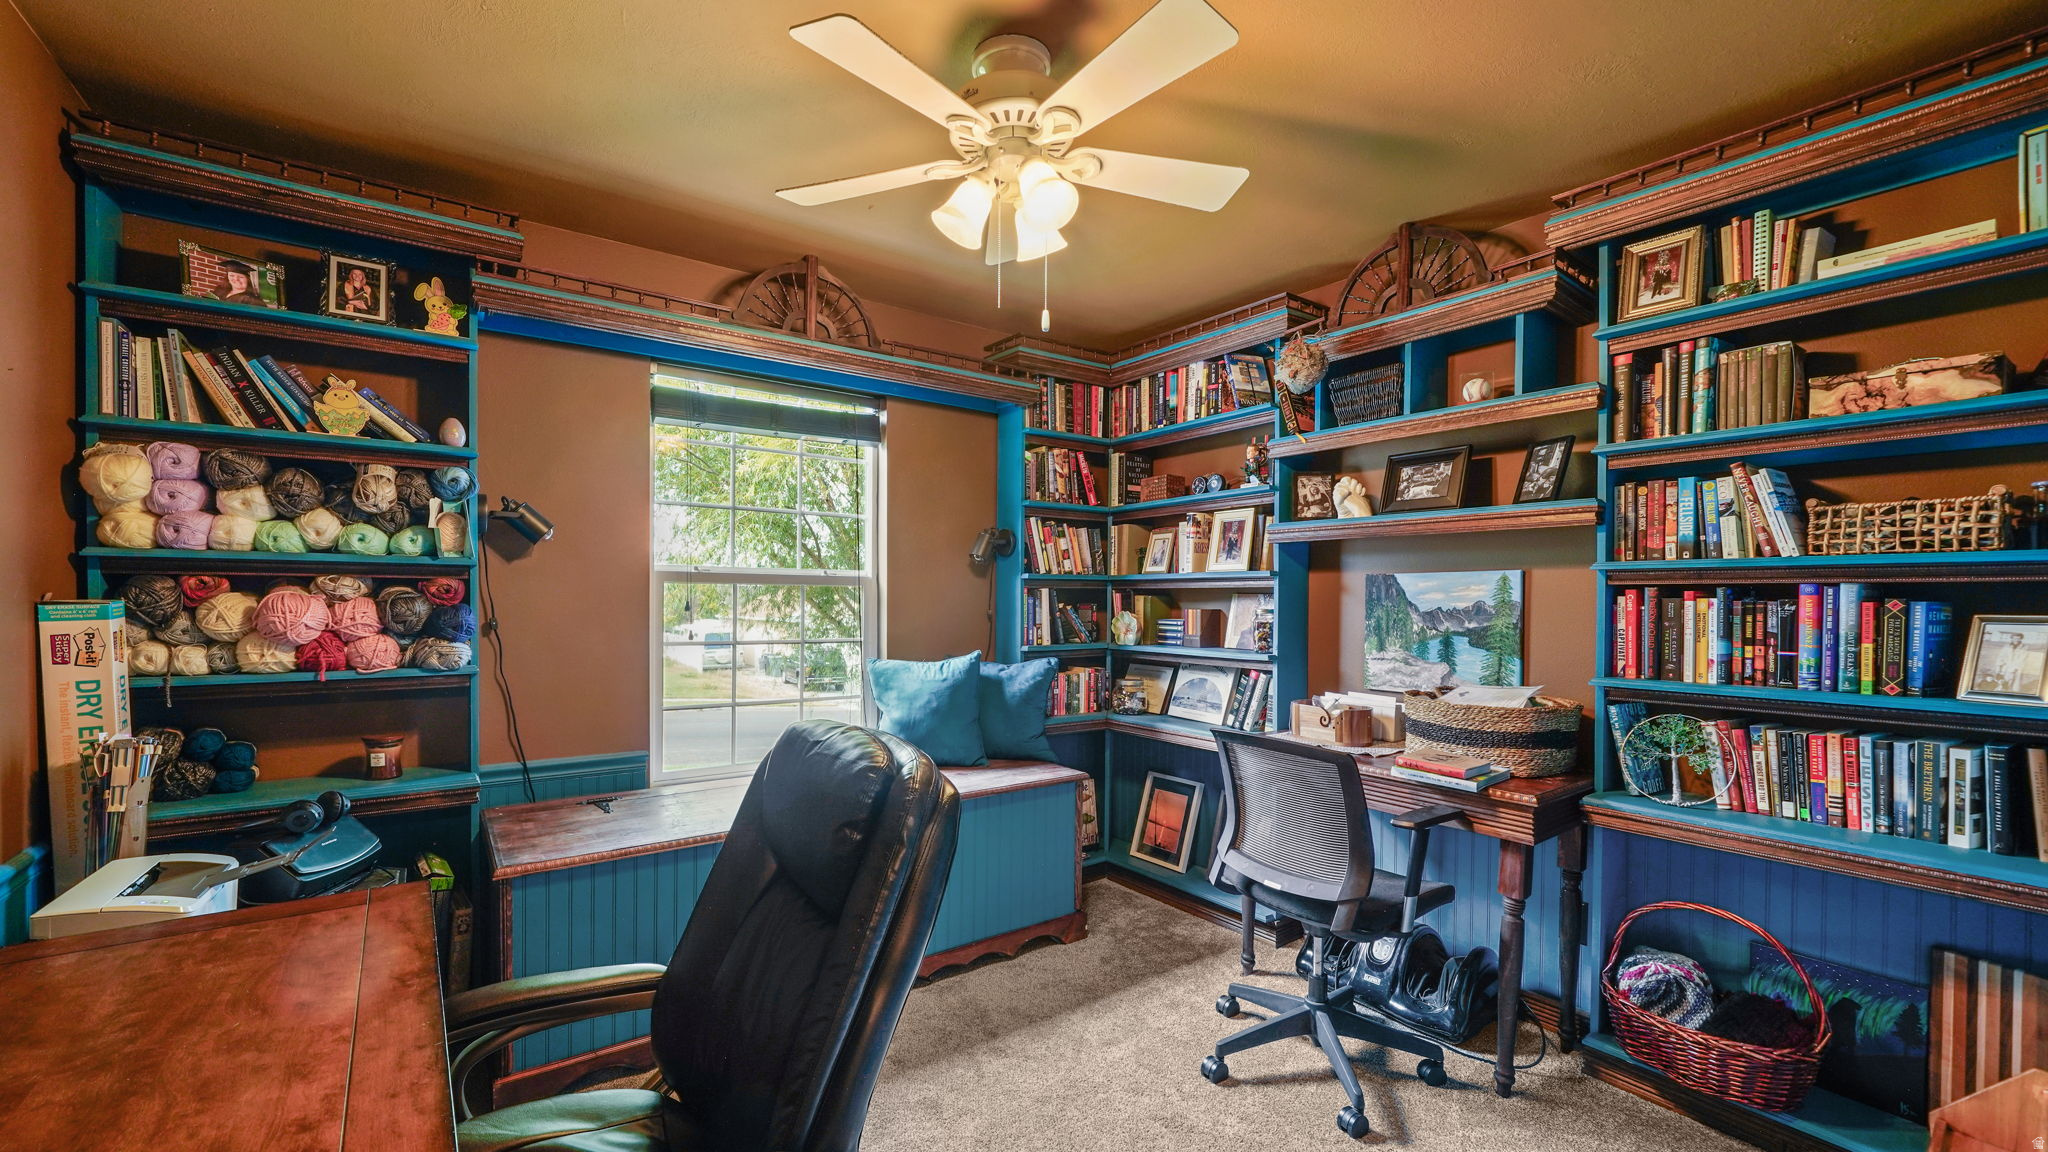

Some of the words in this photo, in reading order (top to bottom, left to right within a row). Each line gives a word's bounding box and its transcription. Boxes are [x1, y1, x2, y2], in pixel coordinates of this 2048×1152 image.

[1681, 359, 1689, 372] GOOD
[219, 352, 241, 378] INDIAN
[244, 389, 266, 415] KILLER
[1642, 380, 1651, 404] ROLLINS
[1681, 374, 1689, 399] MARRIAGE
[1639, 496, 1647, 518] GALLOWS
[1706, 491, 1715, 502] THE
[1733, 467, 1750, 494] NEVER
[1744, 494, 1764, 528] CAUGHT
[1639, 518, 1647, 530] ROCK
[1680, 497, 1694, 536] FELLSIDE
[1707, 502, 1717, 524] FALLOUT
[1805, 598, 1813, 616] ABBY
[1848, 588, 1856, 602] THE
[1848, 603, 1857, 626] WAGER
[1618, 628, 1626, 662] CAPTIVATE
[1805, 618, 1813, 648] JIMENEZ
[1848, 632, 1856, 652] DAVID
[54, 635, 64, 664] Sticky
[63, 635, 71, 662] Super
[84, 632, 98, 664] Post-it
[1847, 653, 1855, 678] GRANN
[75, 680, 103, 719] DRY
[119, 675, 128, 713] DRY
[59, 681, 70, 697] The
[65, 770, 78, 818] whiteboard
[1846, 740, 1854, 758] COLSON
[1924, 744, 1933, 760] THE
[1643, 778, 1663, 794] GROFF
[1847, 760, 1856, 790] WHITEHEAD
[1861, 746, 1872, 820] LESS
[1924, 761, 1934, 802] BRETHREN
